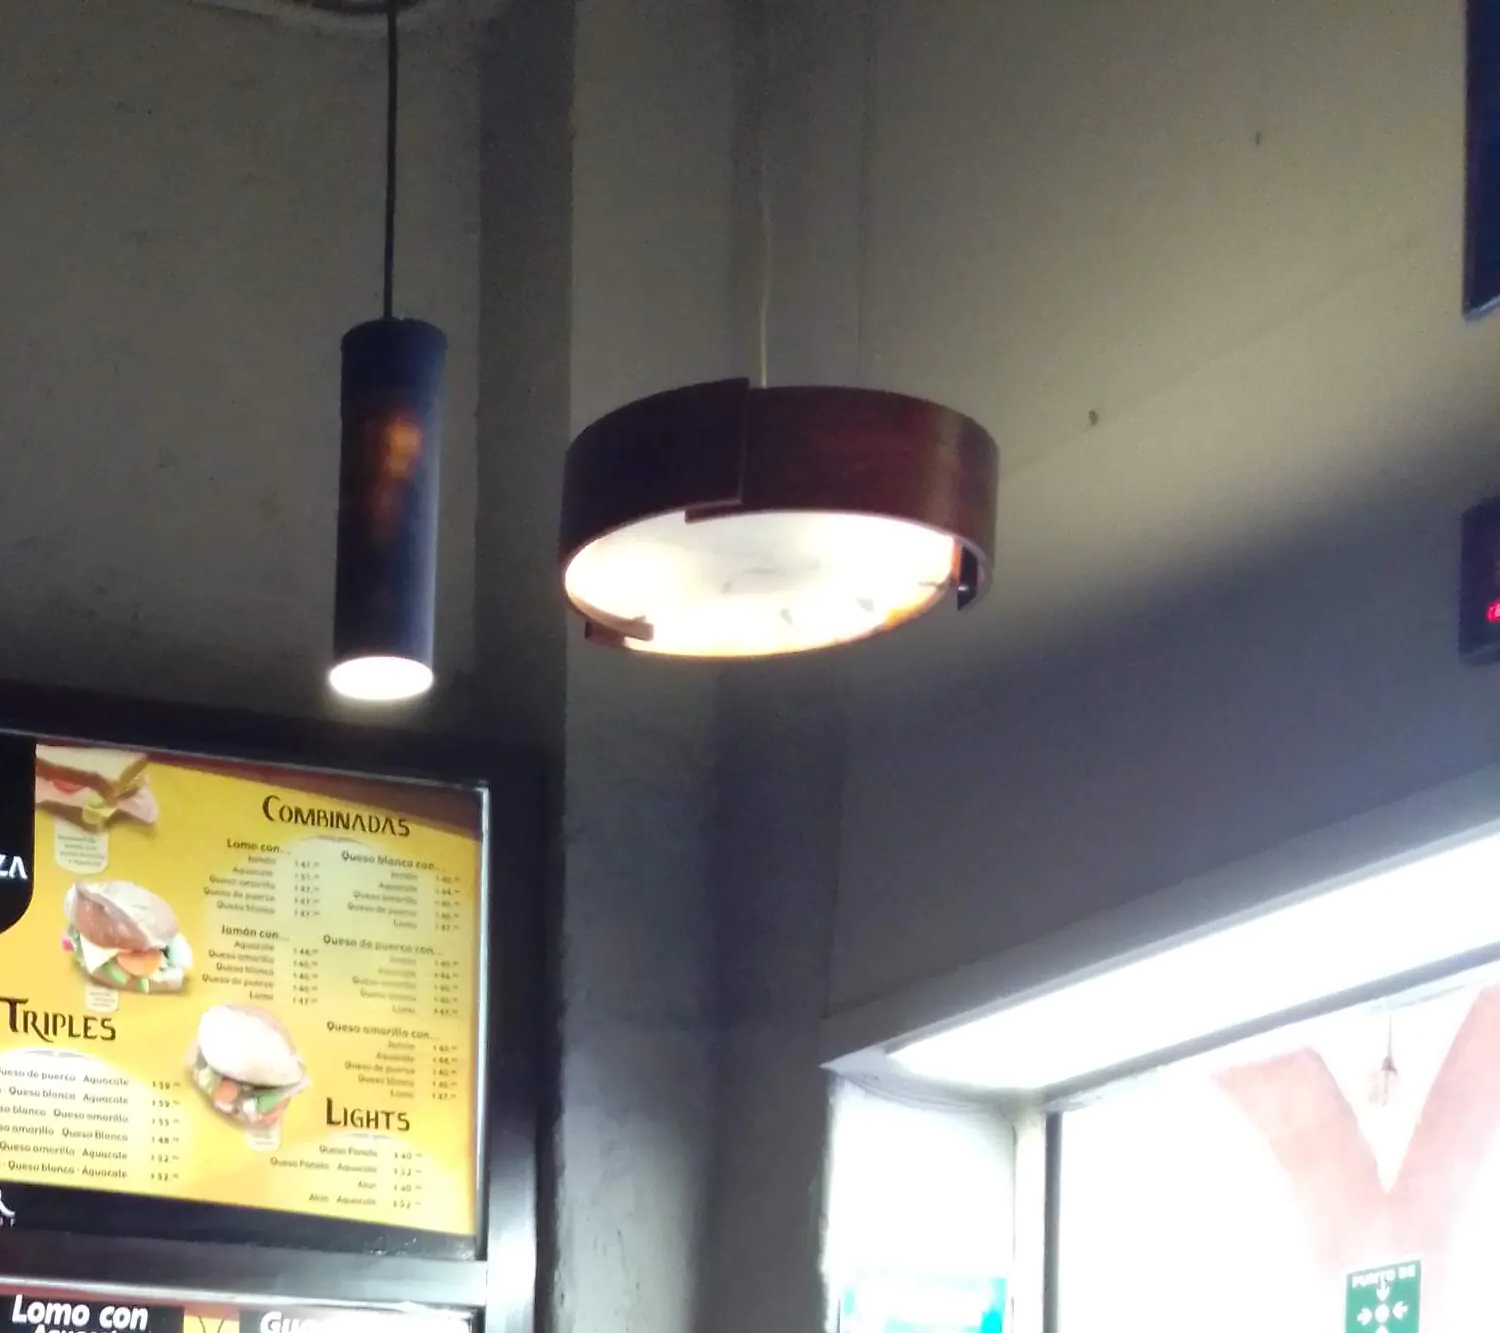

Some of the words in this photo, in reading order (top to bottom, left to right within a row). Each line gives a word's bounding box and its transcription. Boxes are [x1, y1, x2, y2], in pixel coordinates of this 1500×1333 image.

[9, 1086, 40, 1097] Queso
[54, 1108, 84, 1120] Queso
[11, 1294, 90, 1328] Lomo
[99, 1305, 148, 1331] con
